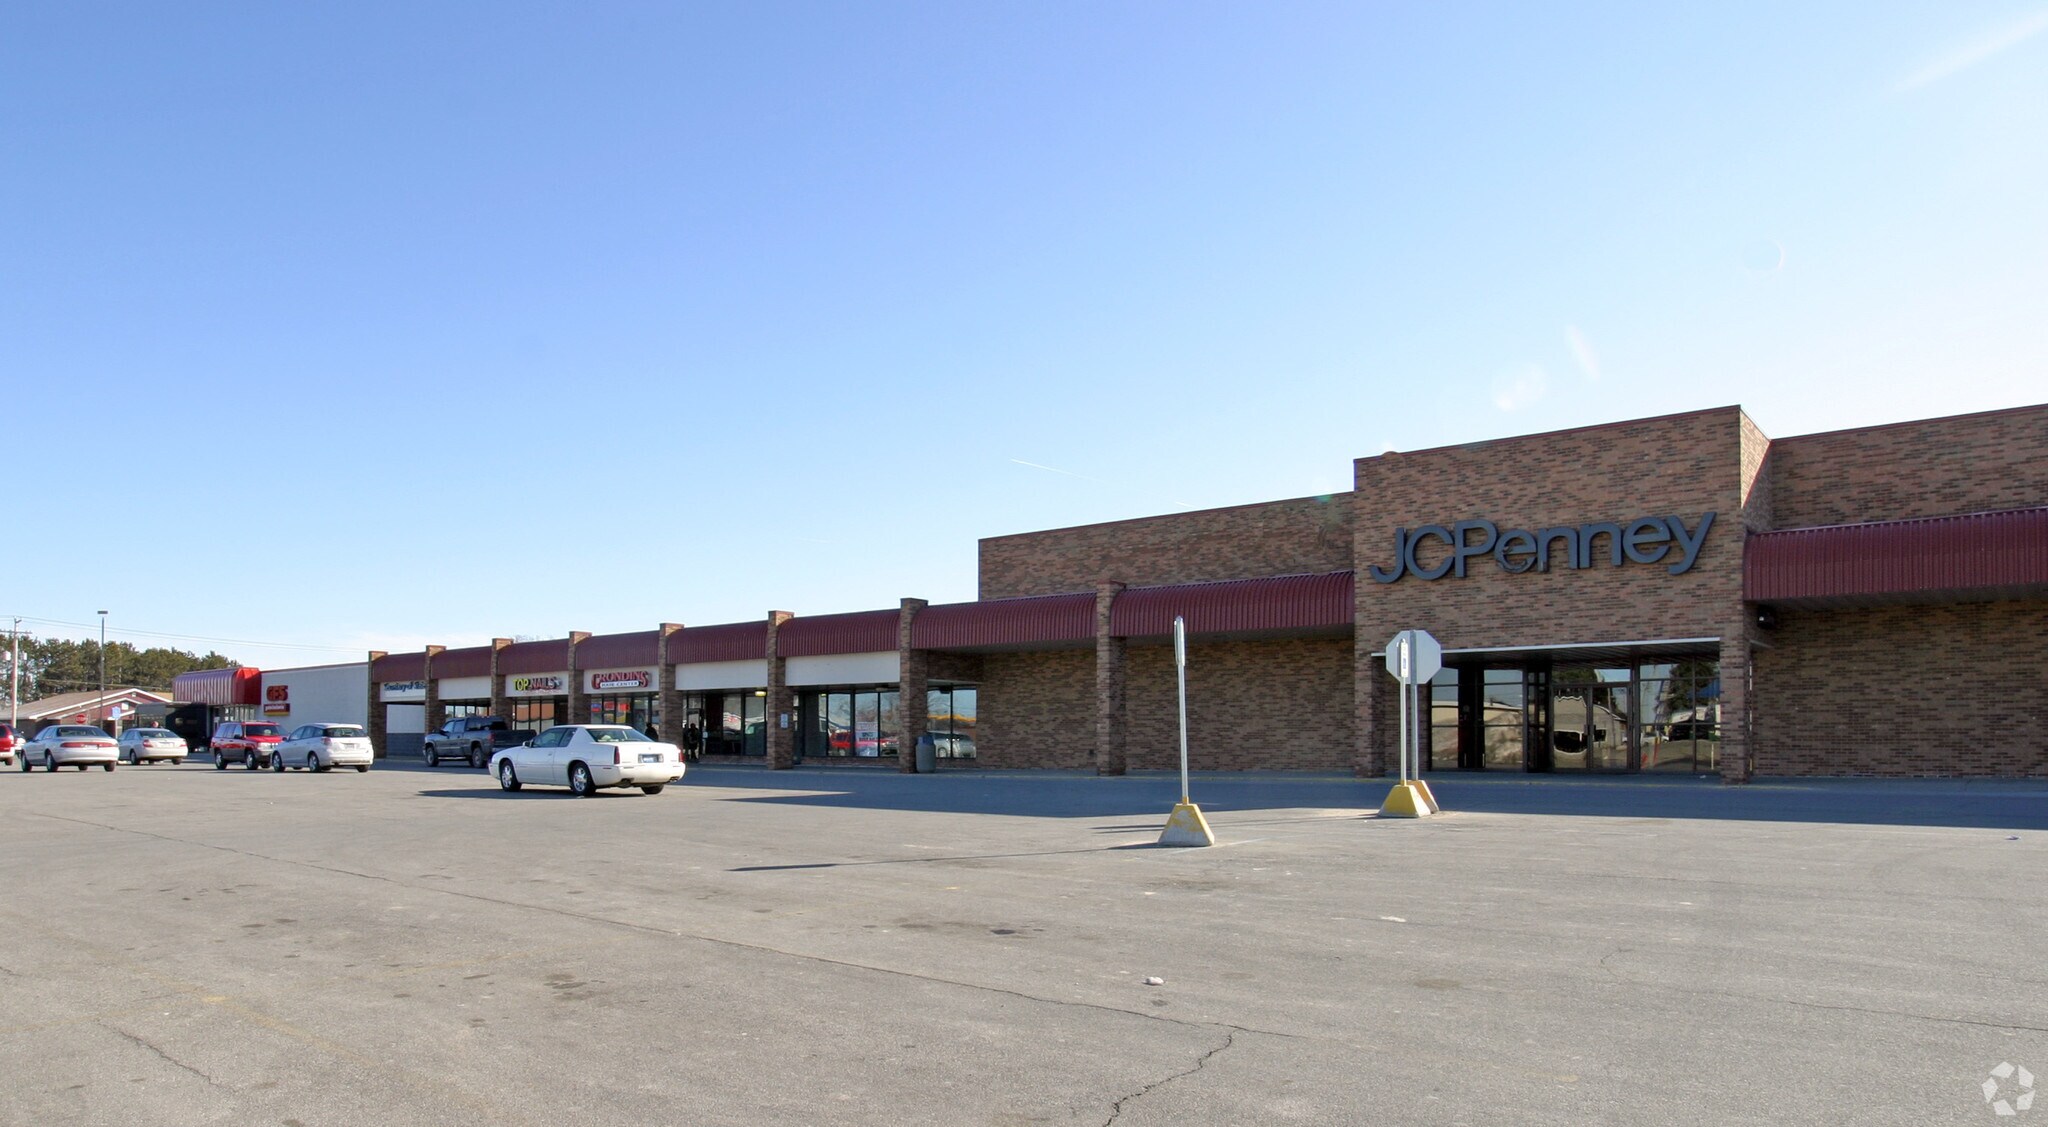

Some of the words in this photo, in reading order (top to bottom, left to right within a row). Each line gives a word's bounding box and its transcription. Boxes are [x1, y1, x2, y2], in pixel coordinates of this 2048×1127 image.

[1370, 511, 1717, 583] JCPenney
[513, 678, 530, 691] TOP
[531, 677, 557, 690] NAILS
